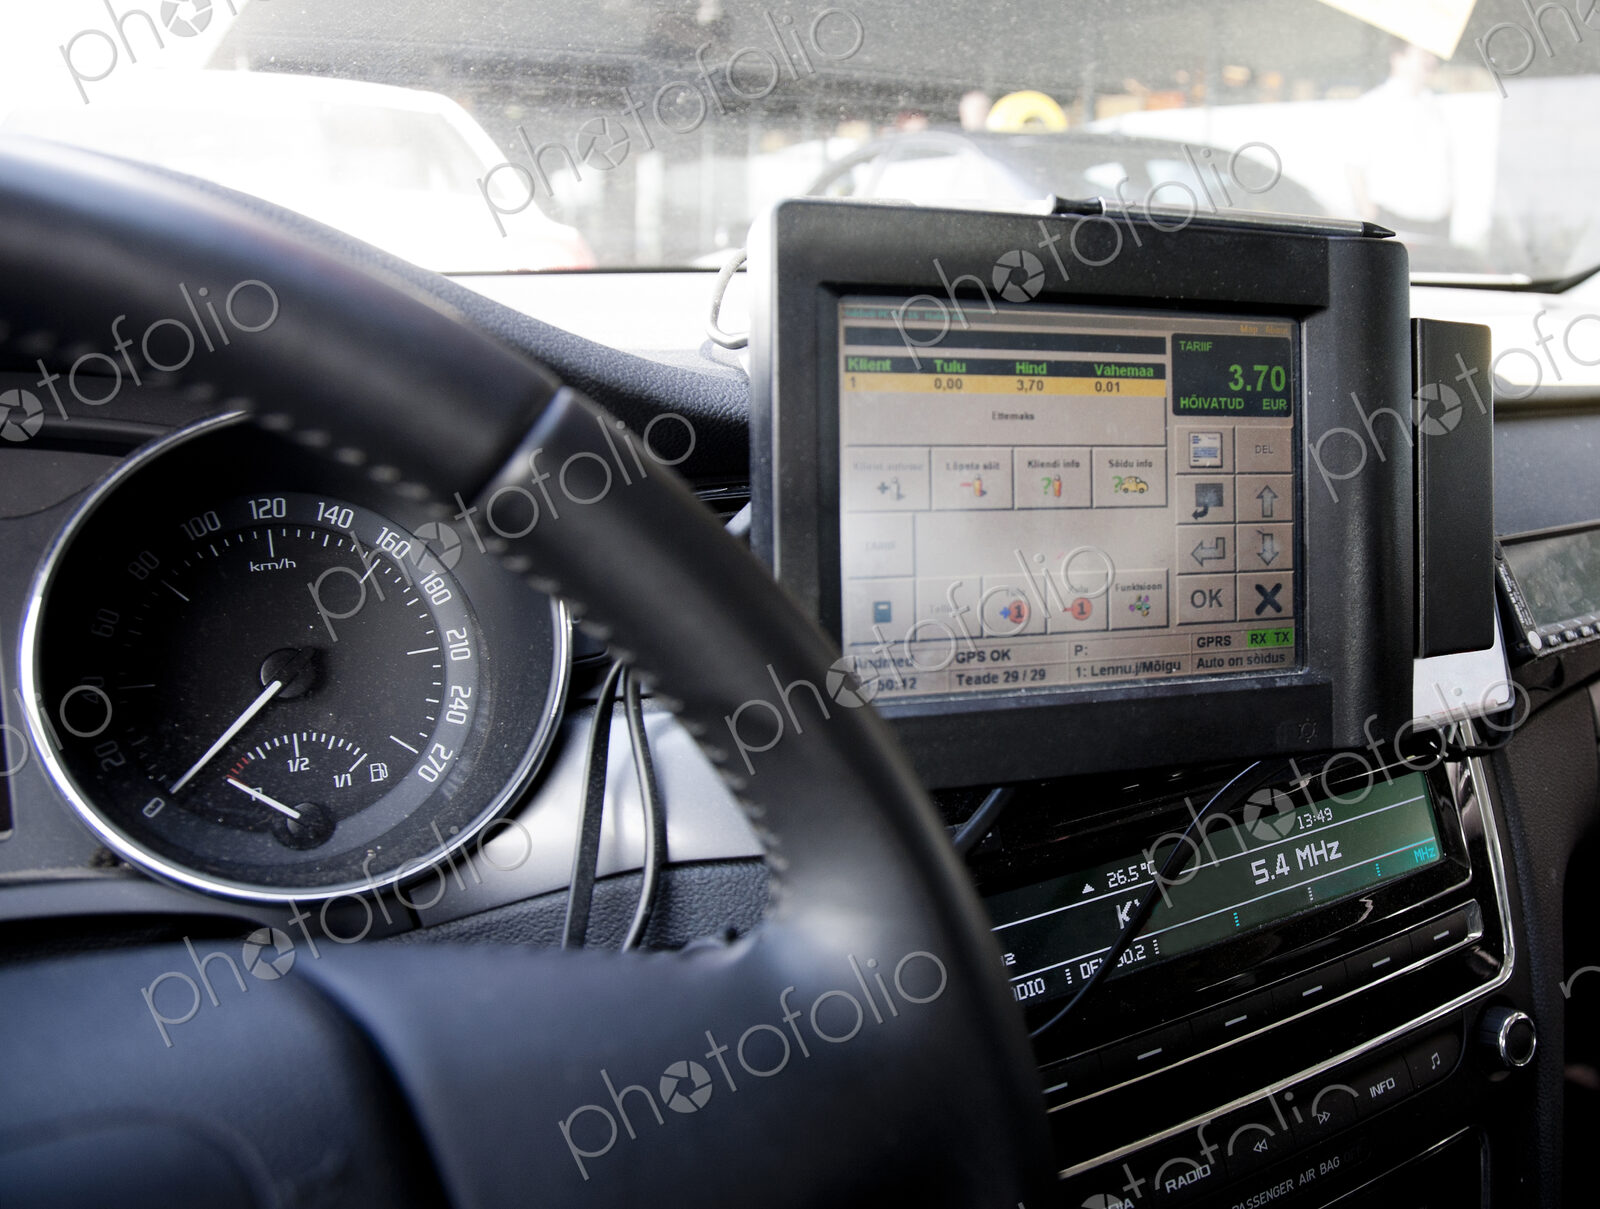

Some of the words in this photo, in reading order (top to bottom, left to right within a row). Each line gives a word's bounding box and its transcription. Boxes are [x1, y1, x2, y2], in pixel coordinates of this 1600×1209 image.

[1179, 341, 1212, 351] TARIIF
[847, 358, 892, 371] Klient
[933, 359, 967, 373] Tulu
[1015, 361, 1048, 375] Hind
[1094, 364, 1154, 377] Vahemaa
[1228, 364, 1286, 392] 3.70
[850, 377, 856, 388] 1
[1094, 381, 1121, 393] 0.01
[1180, 394, 1244, 409] HÕIVATUD
[1262, 398, 1287, 410] EUR
[1255, 445, 1274, 454] DEL
[248, 498, 286, 519] 120
[317, 502, 354, 529] 140
[180, 511, 221, 540] 100
[375, 526, 411, 560] 160
[128, 550, 160, 580] 80
[250, 558, 296, 572] km/h
[420, 570, 452, 606] 180
[1191, 589, 1223, 608] OK
[445, 627, 471, 661] 210
[1196, 635, 1231, 648] GPRS
[1250, 633, 1266, 644] RX
[1274, 631, 1290, 642] TX
[956, 650, 985, 664] GPS
[990, 649, 1011, 662] OK
[1073, 645, 1088, 656] P:
[1076, 666, 1087, 677] 1:
[1196, 656, 1225, 669] Auto
[1229, 656, 1243, 667] on
[956, 672, 998, 686] Teade
[1003, 670, 1019, 683] 29
[1031, 668, 1046, 681] 29
[445, 685, 471, 725] 240
[287, 757, 310, 772] 1/2
[418, 742, 453, 783] 270
[333, 773, 352, 788] 1/1
[142, 797, 165, 818] 0
[1297, 807, 1333, 829] 13:49
[1251, 853, 1290, 885] 5.4
[1295, 838, 1342, 870] MHz
[1413, 846, 1436, 863] MHz
[1011, 977, 1046, 1001] DIO
[1369, 1077, 1395, 1098] INFO
[1165, 1164, 1211, 1193] RADIO
[1299, 1168, 1316, 1186] AIR
[1319, 1156, 1340, 1175] BAG
